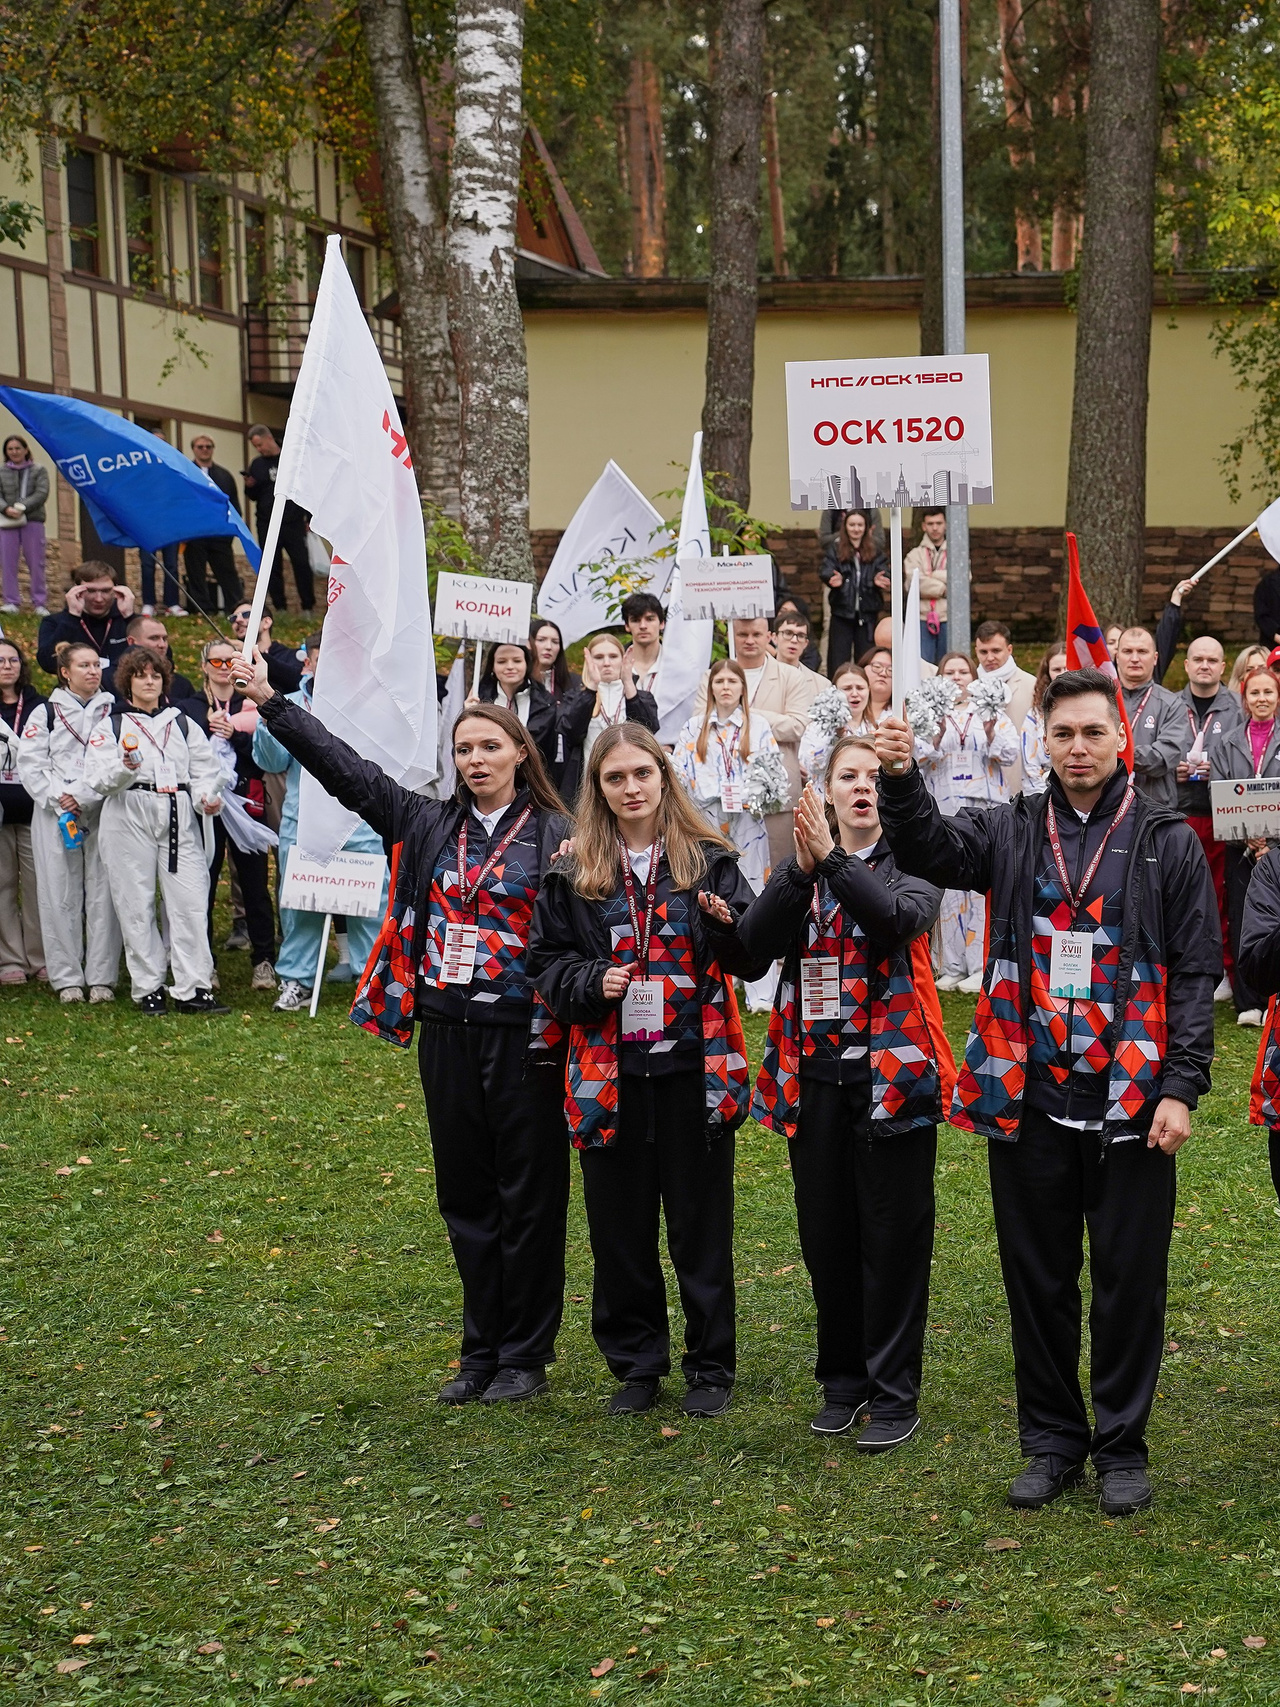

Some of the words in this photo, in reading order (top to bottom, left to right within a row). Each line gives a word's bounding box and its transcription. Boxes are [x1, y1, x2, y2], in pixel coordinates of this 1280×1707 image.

[914, 372, 963, 385] 1520
[813, 418, 887, 446] ОСК
[893, 416, 965, 443] 1520
[455, 600, 512, 617] КОЛДИ
[349, 858, 374, 866] GROUP
[292, 873, 345, 886] КАПИТАЛ
[347, 879, 376, 889] ГРУП
[1061, 945, 1082, 954] XVIII
